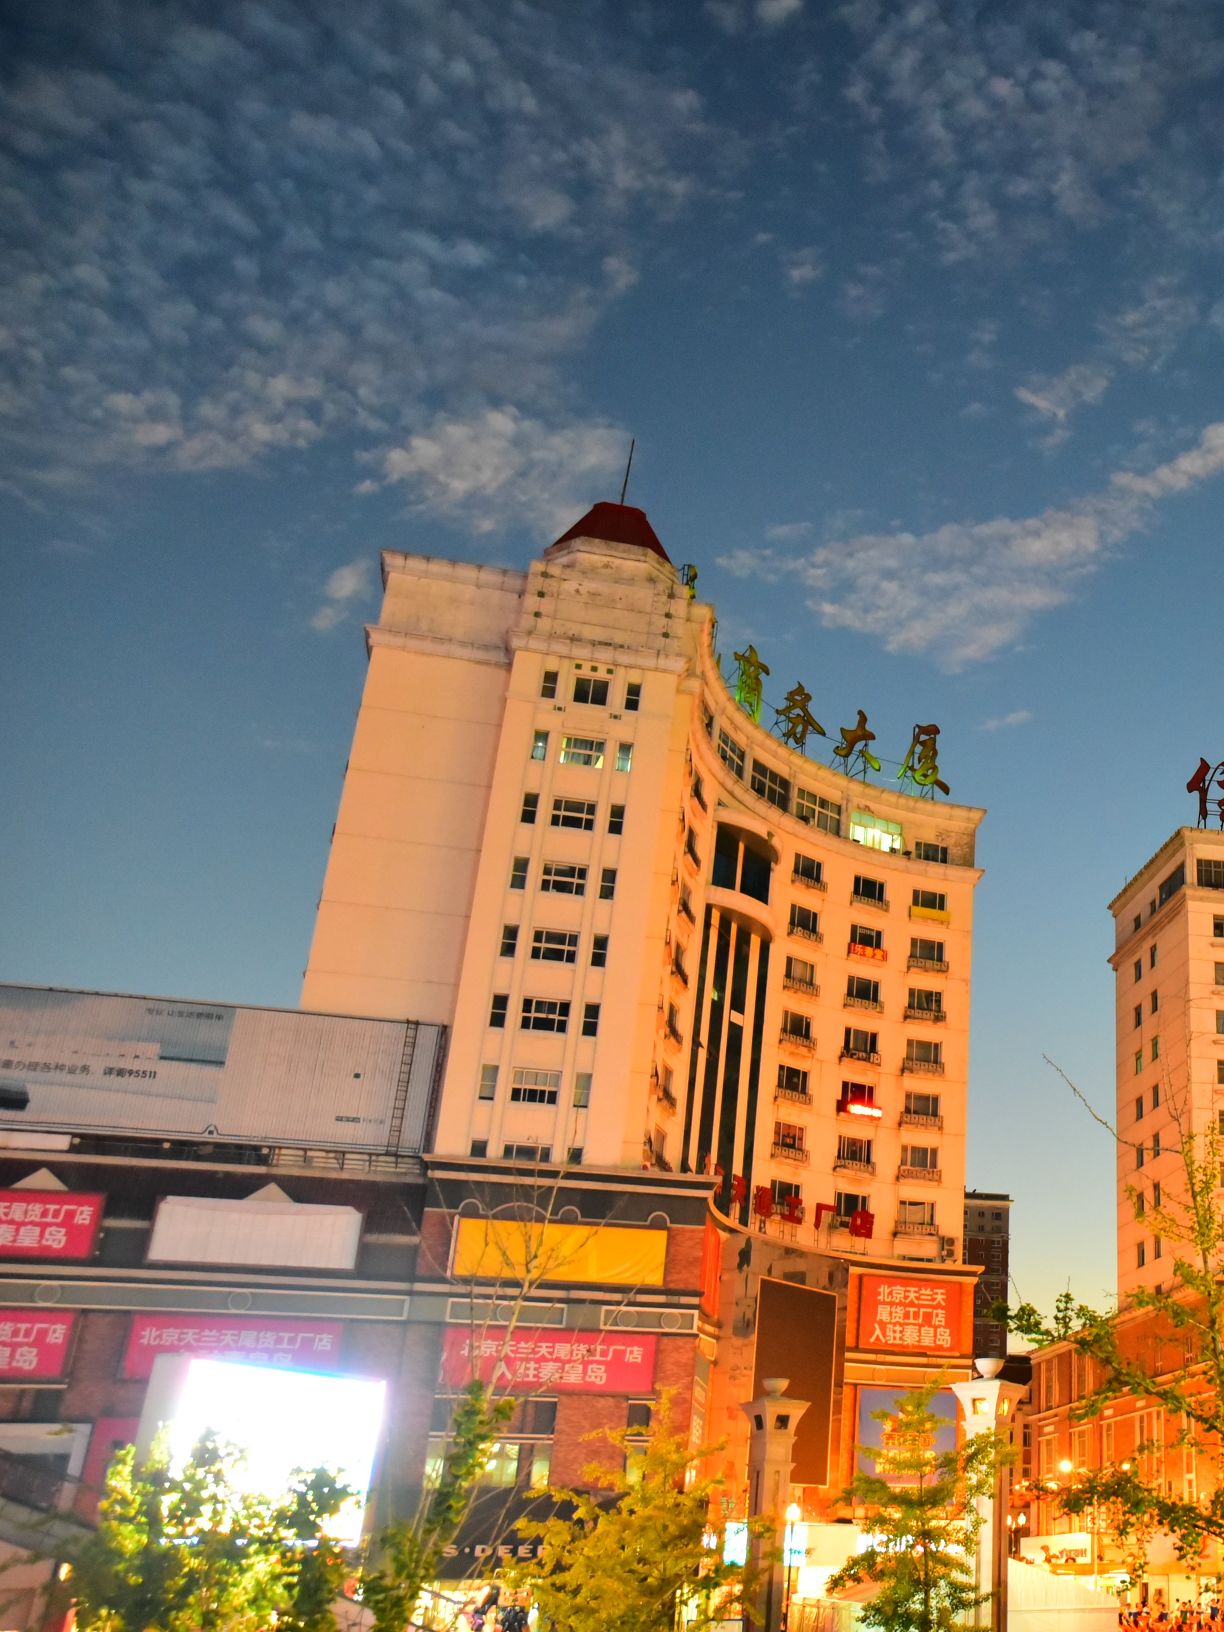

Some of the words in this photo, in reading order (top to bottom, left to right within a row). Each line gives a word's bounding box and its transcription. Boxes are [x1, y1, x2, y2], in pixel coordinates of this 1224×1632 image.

[877, 1285, 947, 1306] 北京天兰天
[876, 1305, 946, 1326] 尾货工厂店
[139, 1327, 335, 1351] 北京天兰天尾货工厂店
[869, 1323, 951, 1348] 入驻秦皇岛
[460, 1339, 644, 1363] 北京天兰天尾货工厂店
[496, 1361, 608, 1385] 入驻秦皇岛
